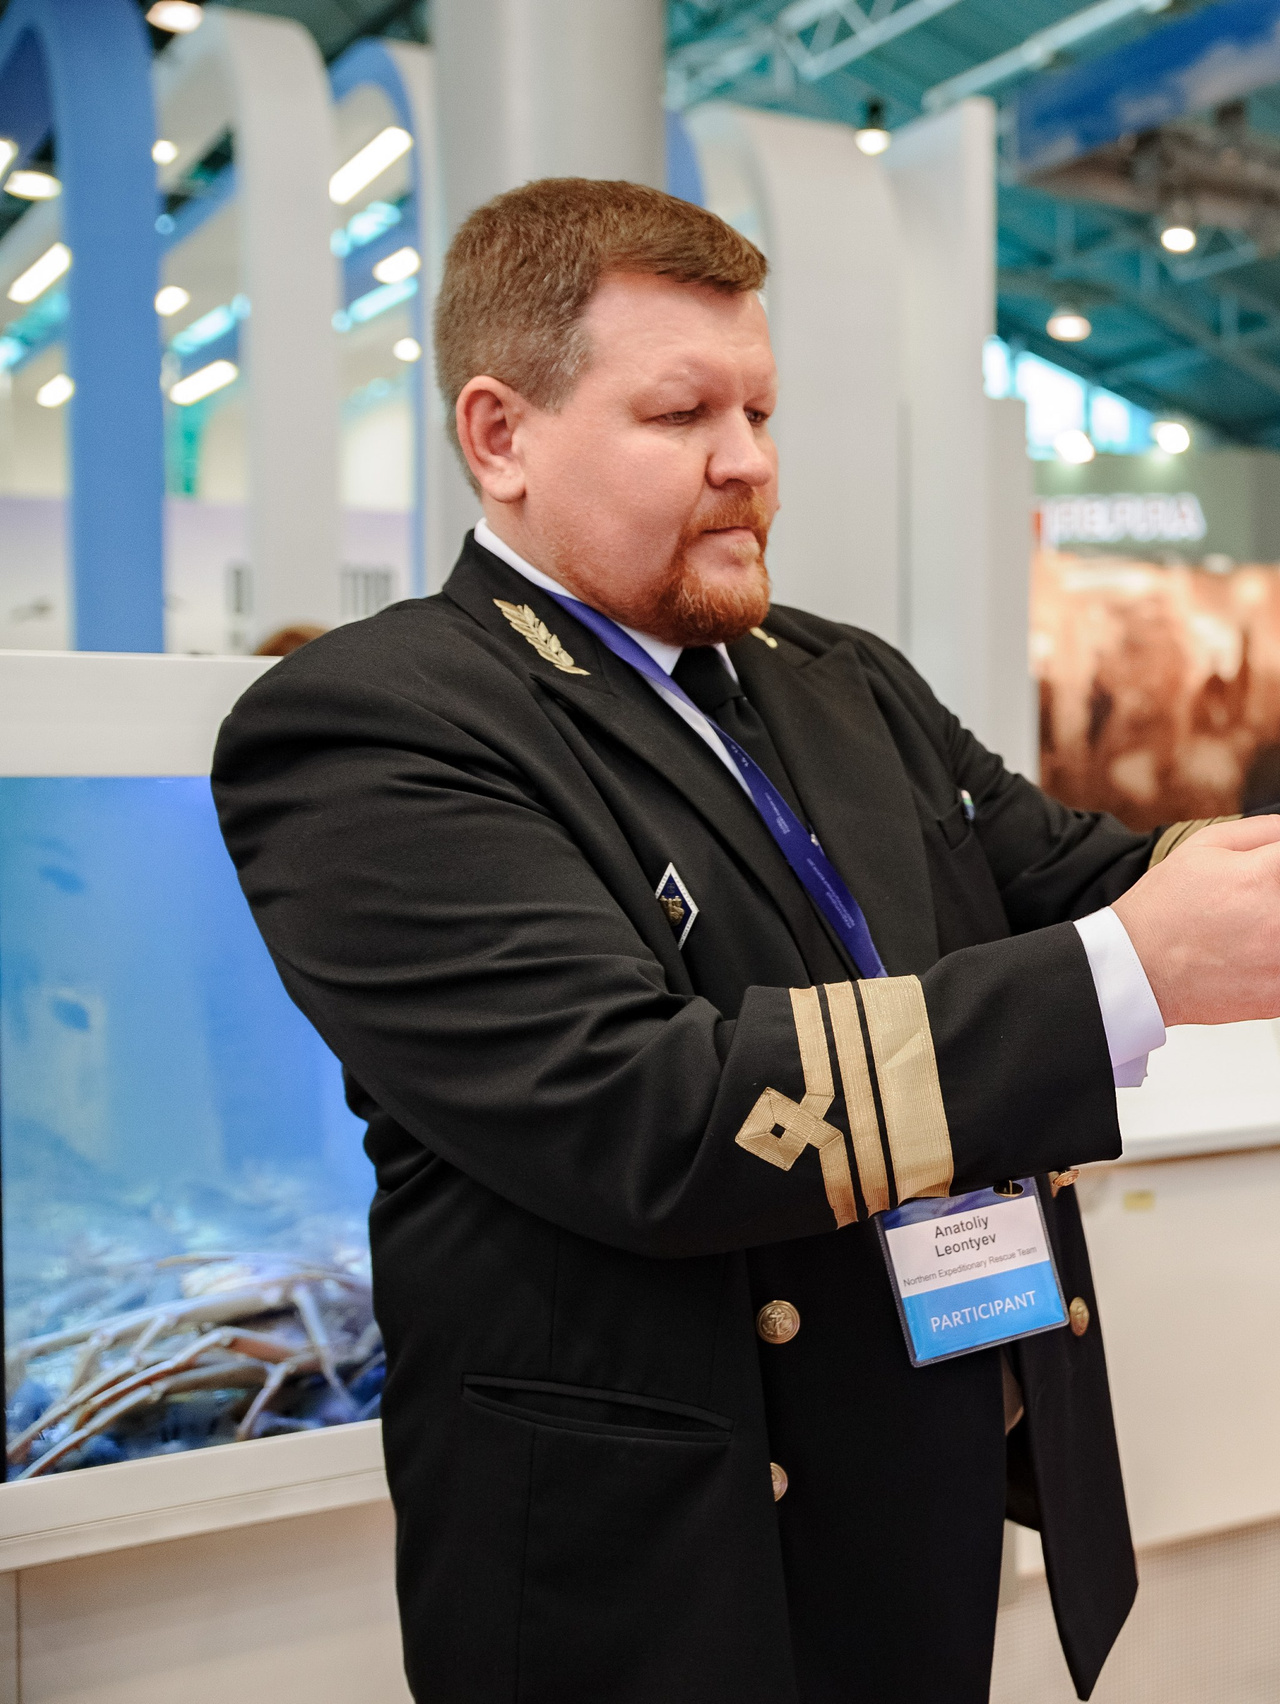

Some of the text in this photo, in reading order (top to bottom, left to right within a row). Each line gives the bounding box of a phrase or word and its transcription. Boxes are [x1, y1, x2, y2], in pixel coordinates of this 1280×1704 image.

[934, 1216, 989, 1239] Anatoliy
[935, 1233, 997, 1257] Leontyev
[903, 1247, 1037, 1287] Northern Expeditionary Rescue Team
[931, 1291, 1036, 1332] PARTICIPANT
